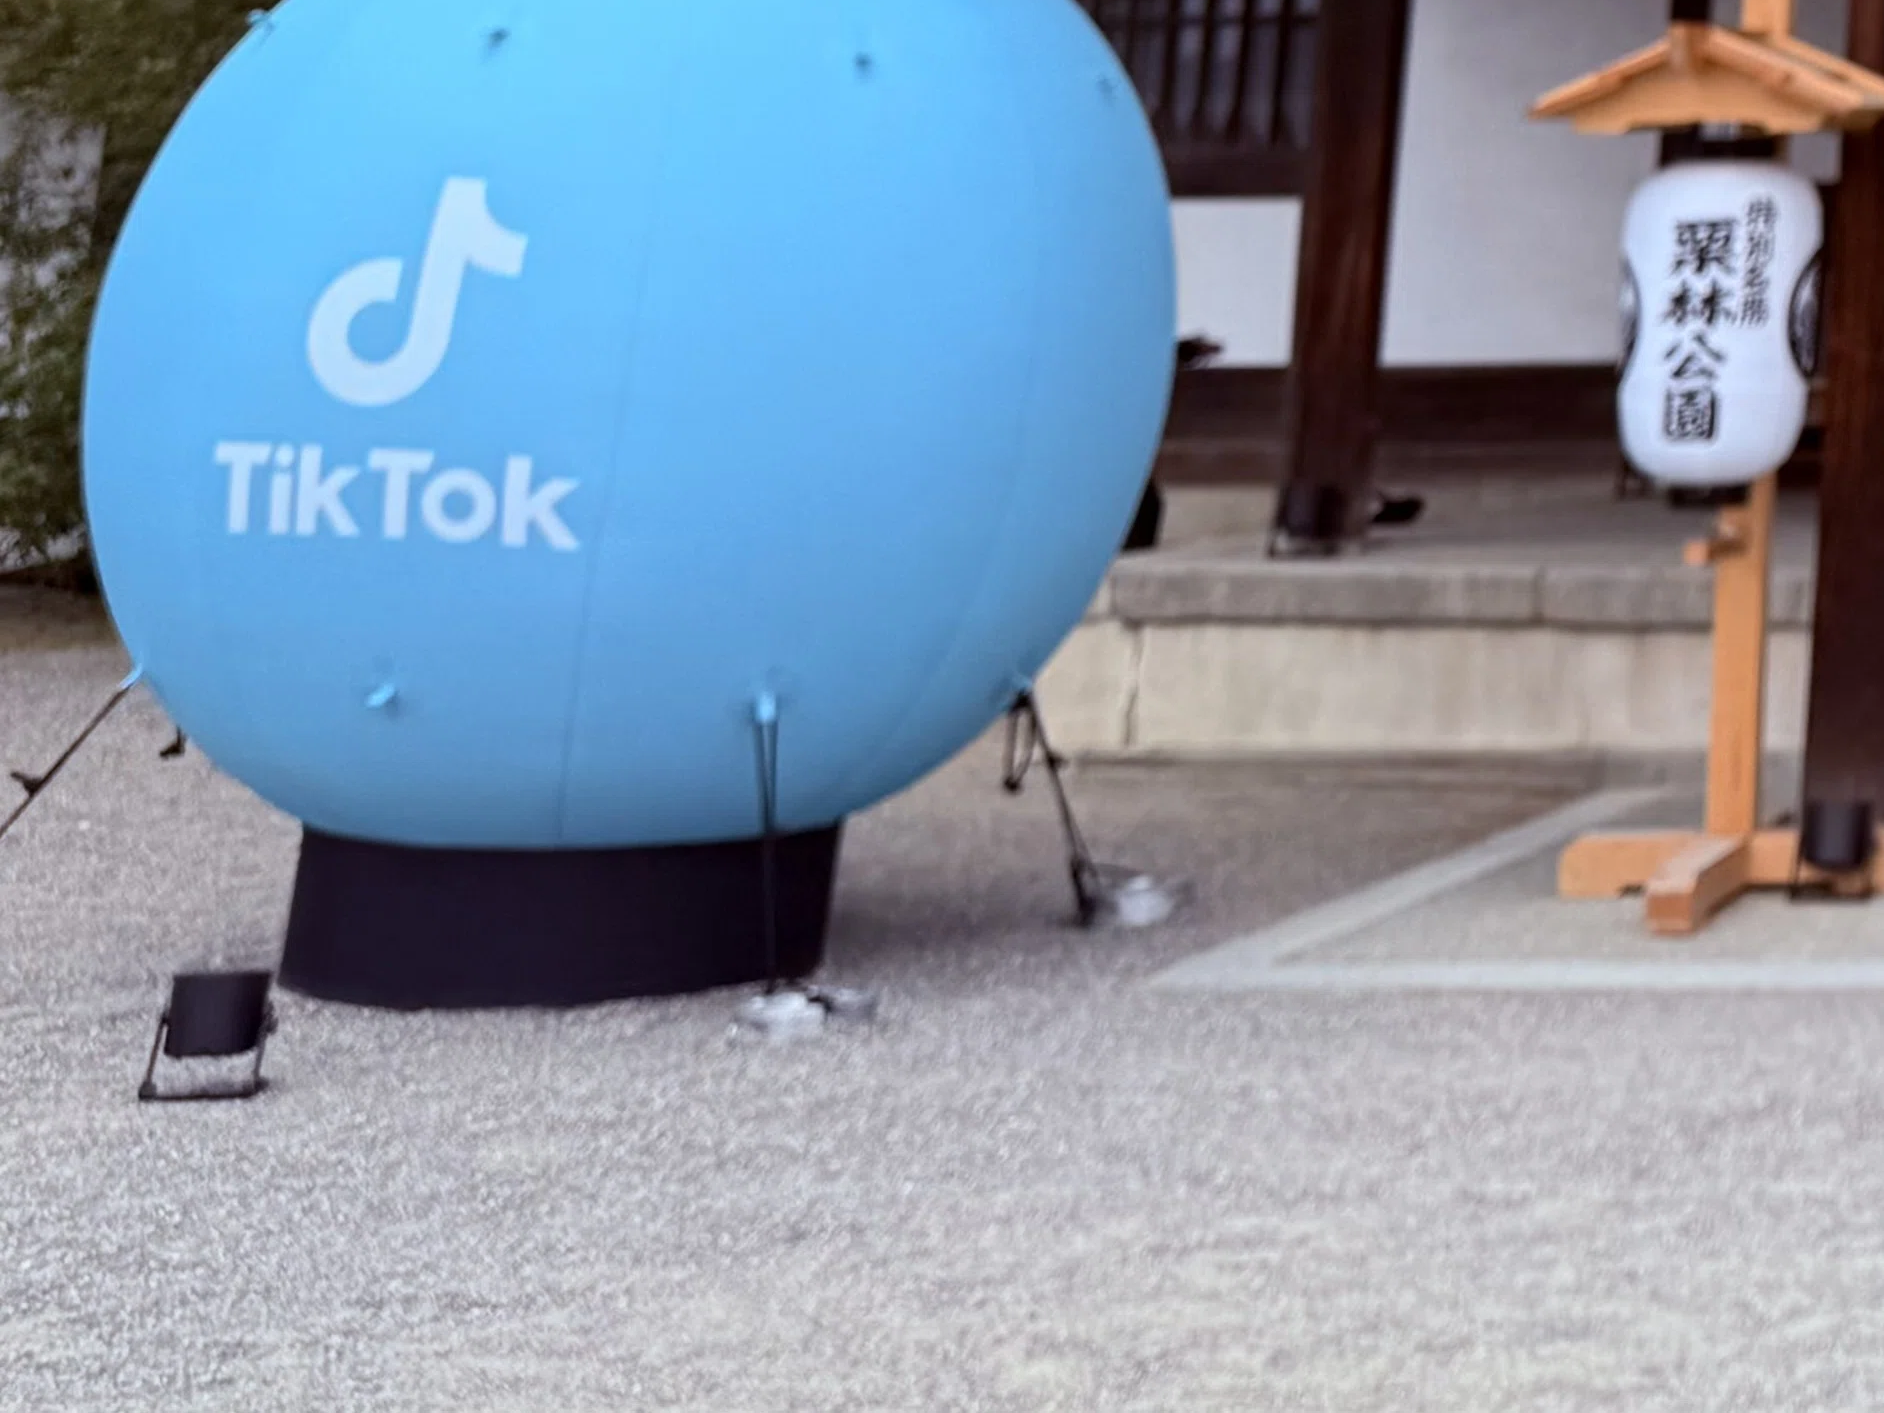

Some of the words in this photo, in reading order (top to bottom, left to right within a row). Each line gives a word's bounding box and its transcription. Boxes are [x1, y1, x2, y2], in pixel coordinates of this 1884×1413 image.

[1663, 219, 1739, 441] 栗林公園
[213, 439, 582, 551] TikTok
